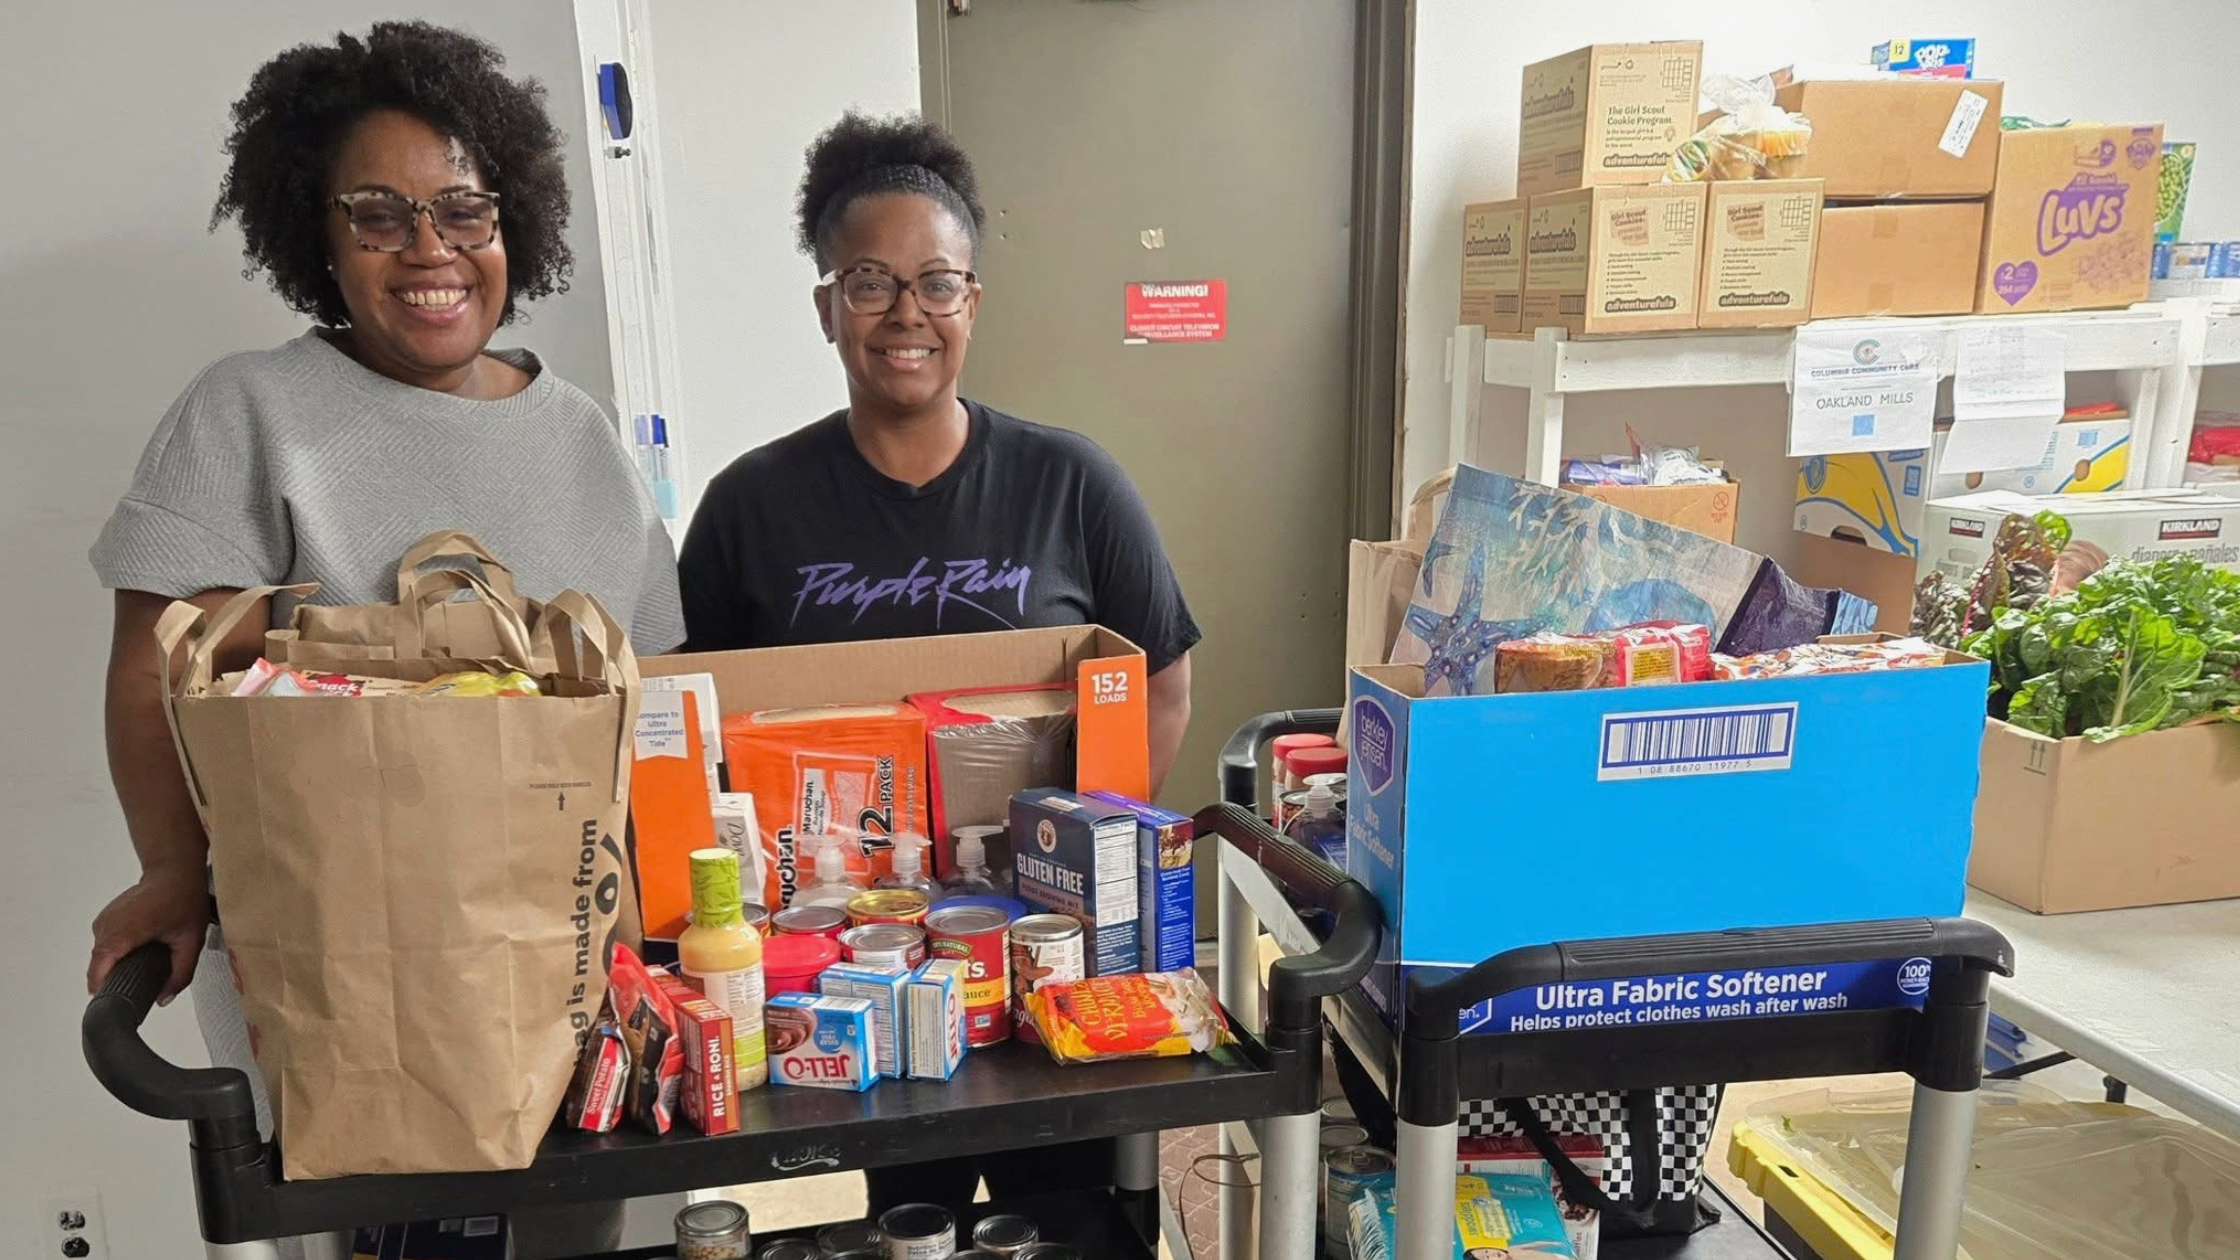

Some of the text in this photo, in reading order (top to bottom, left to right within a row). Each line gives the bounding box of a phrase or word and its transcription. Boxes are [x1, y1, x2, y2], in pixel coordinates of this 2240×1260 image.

[1894, 46, 1905, 55] 12
[1608, 104, 1665, 116] The Girl Scout
[1607, 116, 1672, 127] Cookie Program
[1603, 153, 1669, 168] adventureful
[1141, 284, 1209, 298] WARNING!
[1719, 291, 1791, 307] adventurefuls
[1605, 296, 1677, 313] adventurefuls
[1816, 392, 1914, 410] OAKLAND MILLS
[1951, 519, 1983, 532] KIRKLAND
[2162, 520, 2219, 533] KIRKLAND
[790, 556, 1032, 627] Purple Rain
[1091, 671, 1129, 694] 152
[1093, 692, 1127, 705] LOADS
[637, 711, 680, 720] ompare to
[648, 720, 668, 728] Ultra
[635, 728, 684, 738] Concentrated
[1361, 708, 1389, 750] berkley
[1650, 766, 1663, 774] 08
[1669, 763, 1701, 773] 88670
[1709, 760, 1739, 771] 11977
[1746, 760, 1752, 768] 5
[858, 754, 896, 858] 12 PACK
[572, 819, 598, 887] from
[1016, 852, 1055, 886] GLUTEN
[1055, 866, 1085, 896] FREE
[570, 894, 591, 977] made
[566, 982, 586, 1006] is
[963, 988, 991, 1000] auce
[1535, 970, 1828, 1011] Ultra Fabric Softener
[1511, 992, 1848, 1032] Helps protect clothes wash after wash
[594, 1057, 611, 1087] Potato
[587, 1087, 602, 1115] Sweet
[711, 1084, 725, 1117] RICE
